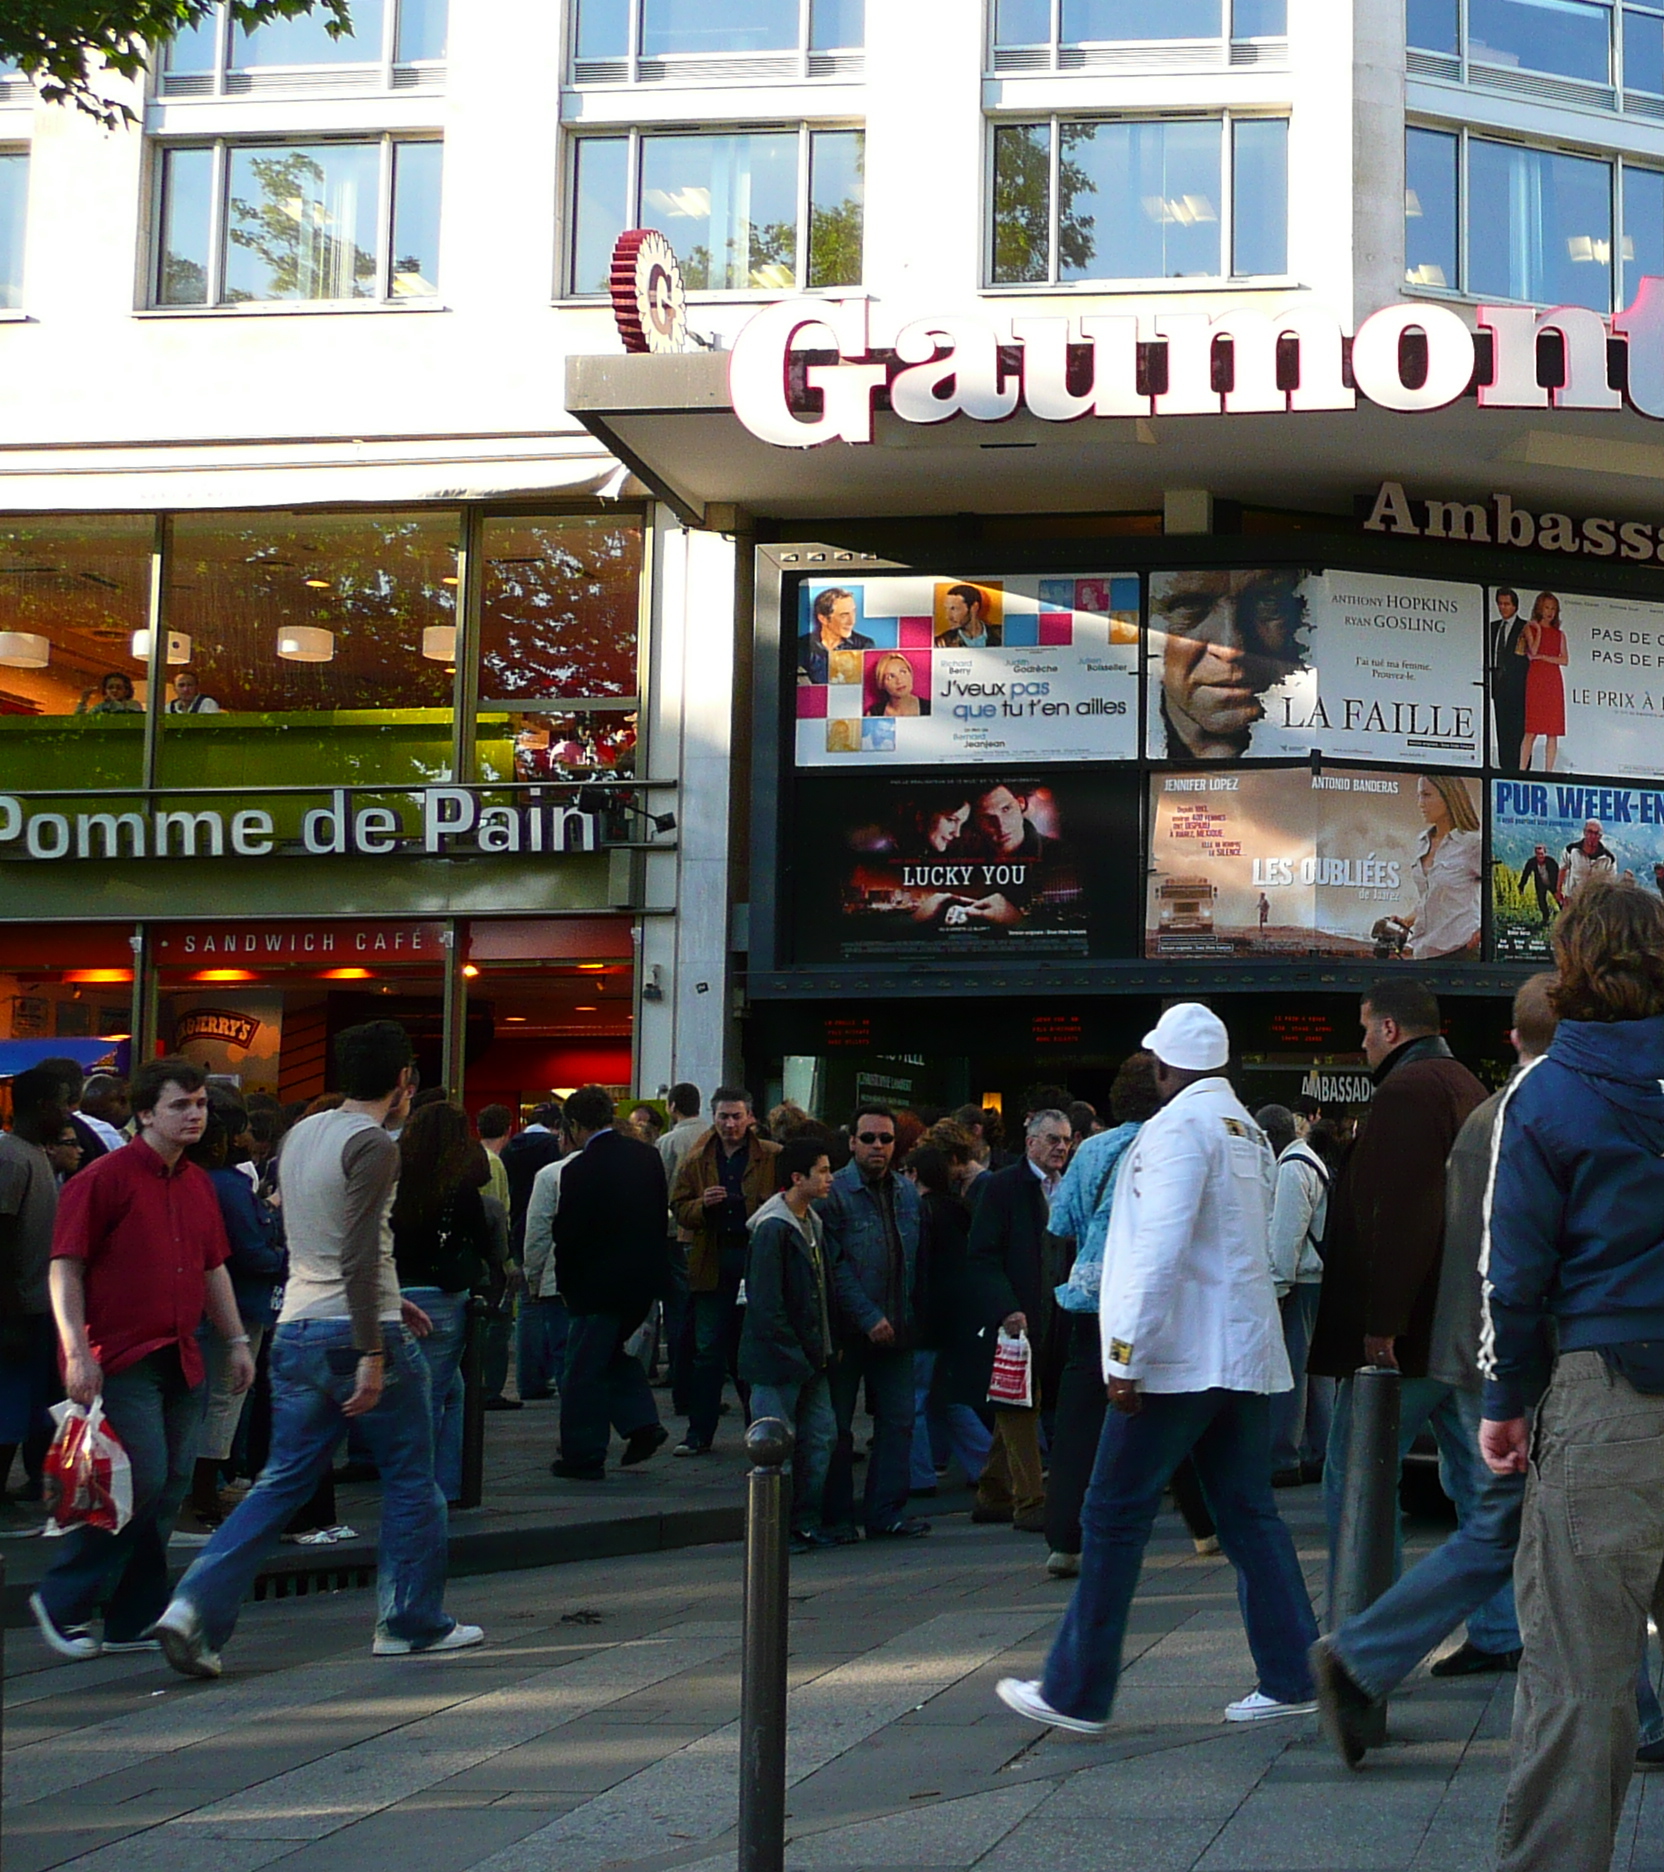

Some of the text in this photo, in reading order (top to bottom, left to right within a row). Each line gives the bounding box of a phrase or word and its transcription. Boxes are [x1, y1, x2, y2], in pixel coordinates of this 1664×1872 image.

[1331, 594, 1458, 614] ANTHONY HOPKINS
[1344, 614, 1446, 633] RYAN GOSLING
[1591, 628, 1623, 642] PAS
[1630, 632, 1651, 646] DE
[1592, 650, 1624, 664] PAS
[1630, 653, 1652, 667] DE
[941, 680, 1050, 700] J'veux pas
[1572, 688, 1590, 706] LE
[1597, 690, 1635, 710] PRIX
[1641, 690, 1655, 711] À
[953, 698, 1127, 722] que tu t'en ailles
[1281, 696, 1475, 738] LA FAILLE
[1164, 778, 1239, 792] JENNIFER LOPEZ
[1311, 776, 1399, 794] ANTONIO BANDERAS
[1496, 782, 1548, 817] PUR
[303, 789, 397, 854] de
[425, 788, 596, 853] Pain
[903, 865, 1026, 886] LUCKY YOU
[1252, 853, 1400, 889] LES OUBLIÉES
[184, 928, 422, 953] SANDWICH CAFÉ
